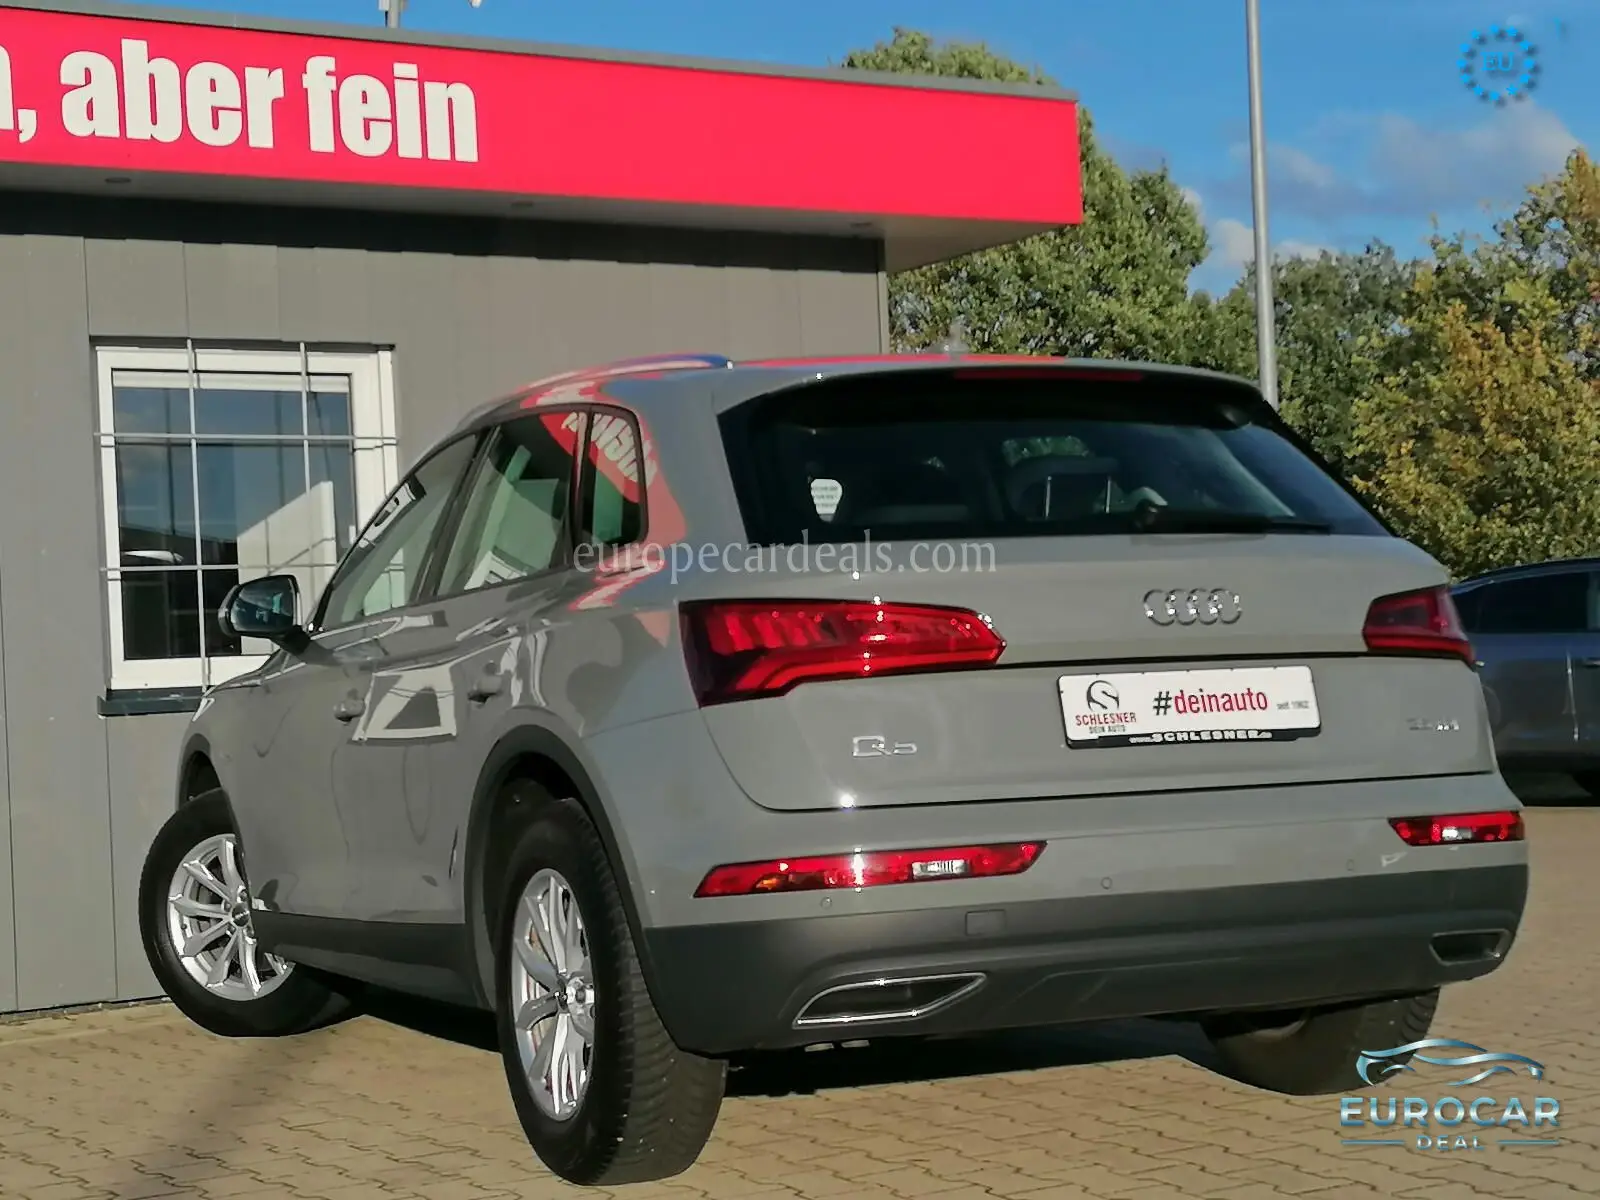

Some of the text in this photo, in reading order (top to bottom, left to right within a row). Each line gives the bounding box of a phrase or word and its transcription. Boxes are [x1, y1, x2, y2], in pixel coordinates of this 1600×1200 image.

[59, 38, 285, 149] aber
[302, 55, 479, 162] fein
[1152, 687, 1268, 716] #deinauto
[1075, 712, 1137, 727] SCHLESNER
